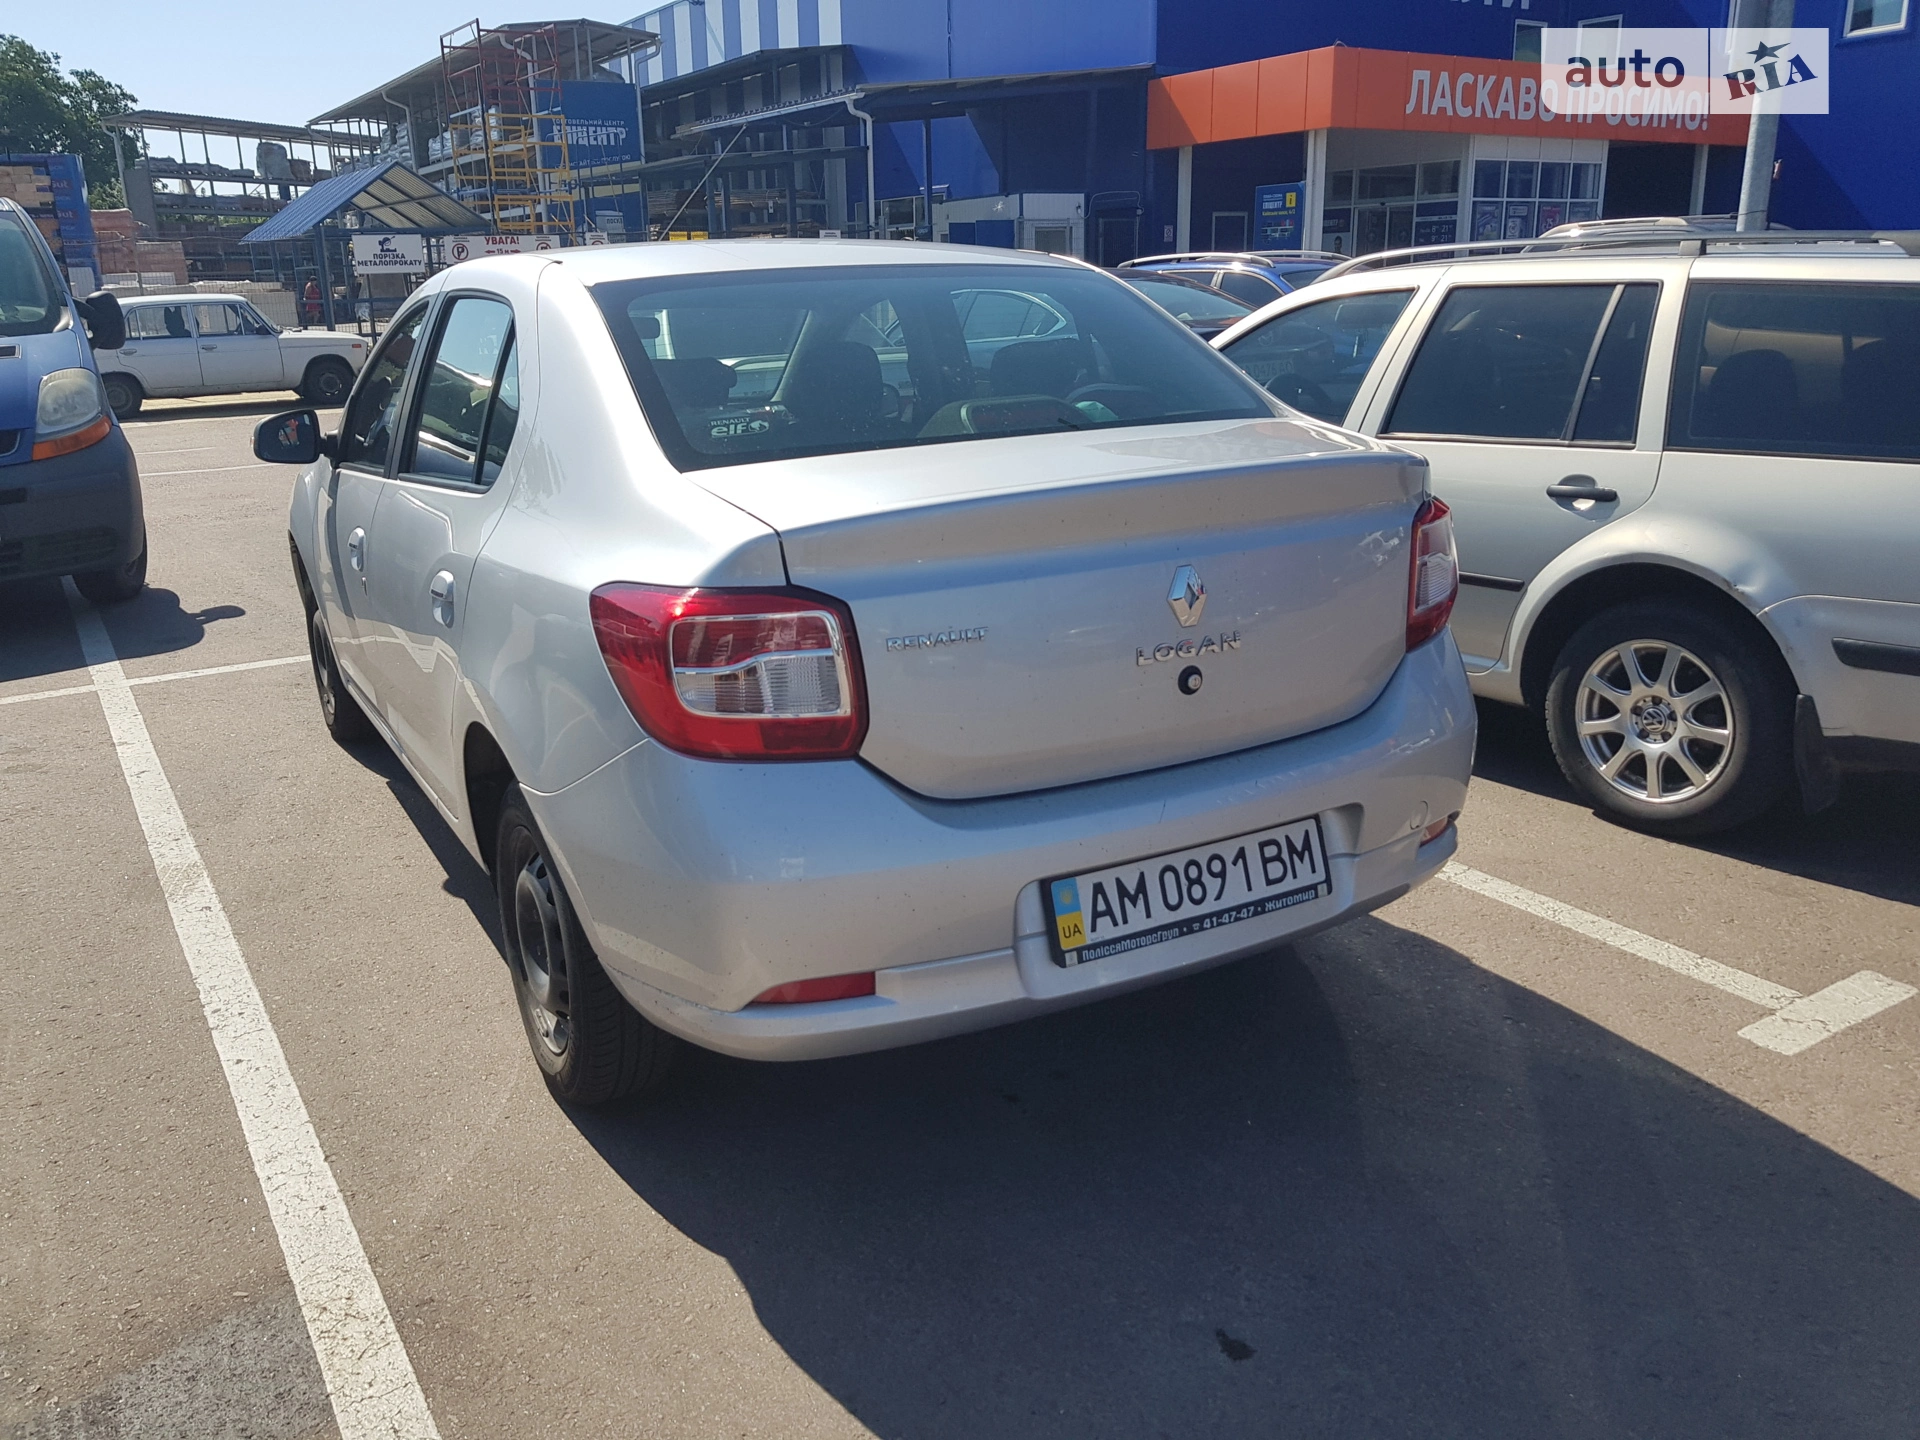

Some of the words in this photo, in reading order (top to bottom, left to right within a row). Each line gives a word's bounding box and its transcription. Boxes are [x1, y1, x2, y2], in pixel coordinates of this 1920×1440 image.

[1405, 69, 1557, 121] ЛАСКАВО
[1566, 81, 1711, 131] ПРОСИМО!
[484, 236, 520, 245] УВАГА!
[357, 259, 423, 267] МЕТАЛОПРОКАТУ
[710, 417, 751, 426] RENAULT
[711, 423, 748, 436] elf
[885, 626, 989, 652] RENAULT
[1135, 630, 1241, 667] LOGAN
[1090, 871, 1152, 933] AM
[1158, 846, 1253, 912] 0891
[1258, 828, 1317, 887] BM
[1203, 906, 1255, 929] 41-47-47
[1265, 889, 1316, 912] Житомир
[1062, 923, 1083, 939] UA
